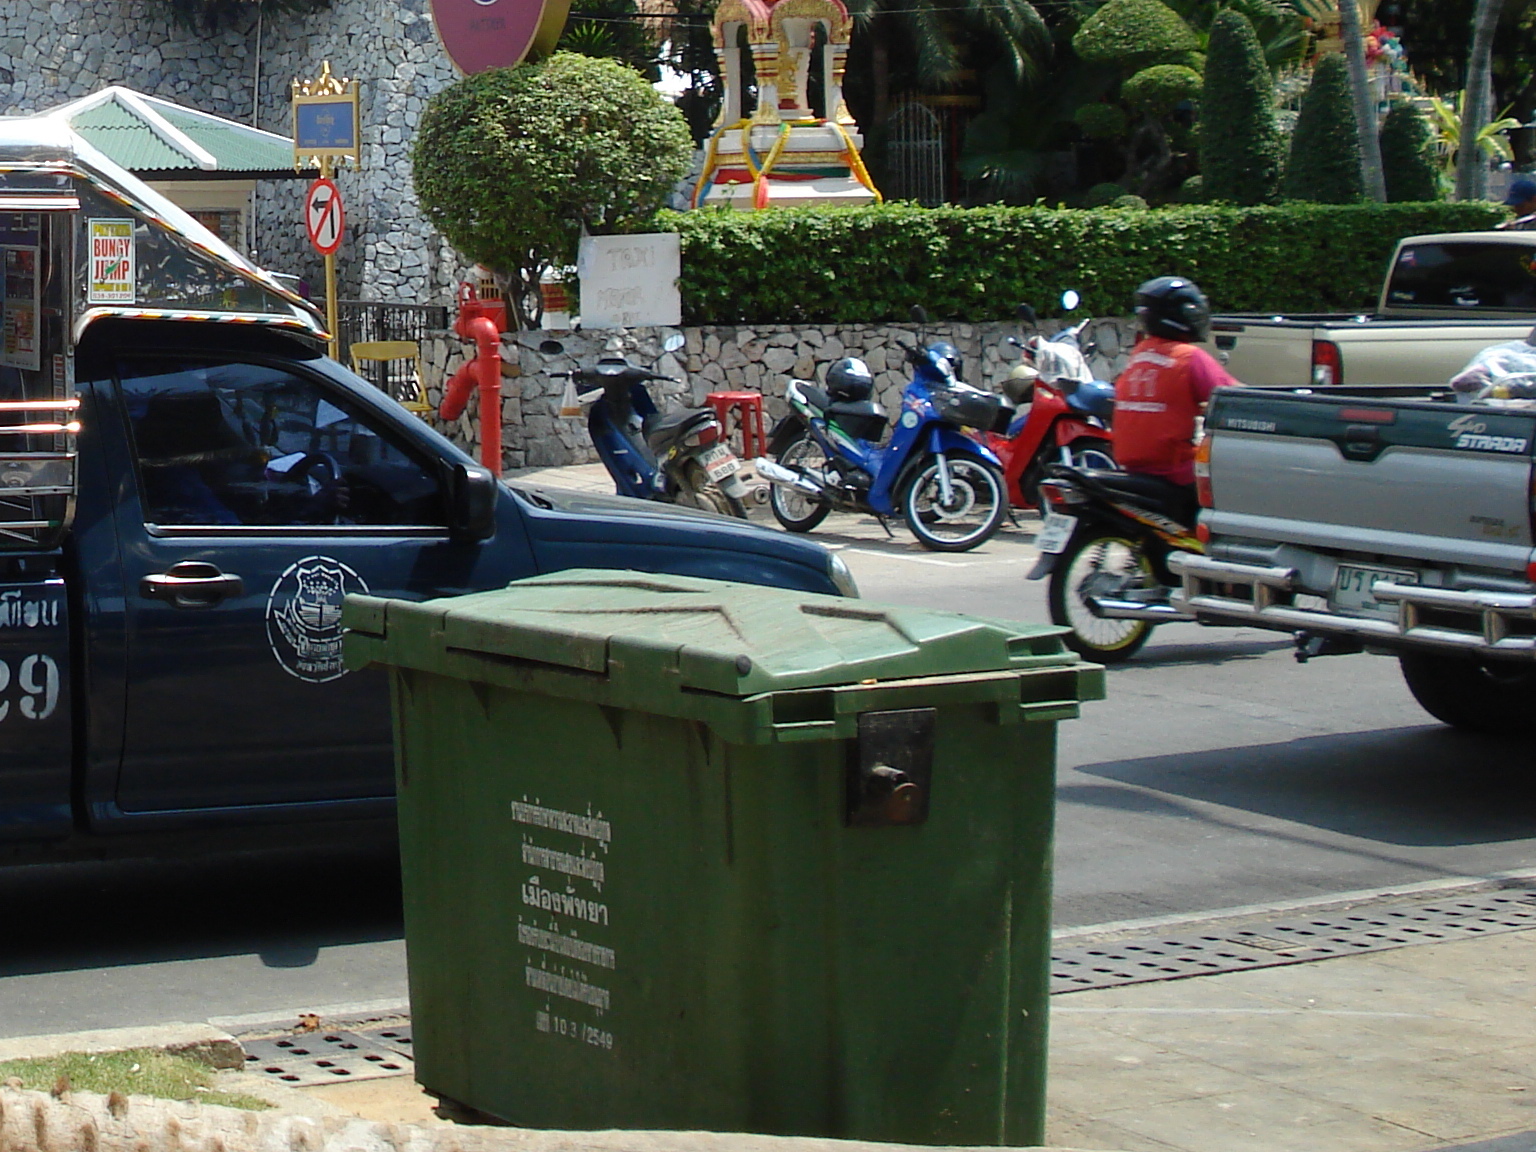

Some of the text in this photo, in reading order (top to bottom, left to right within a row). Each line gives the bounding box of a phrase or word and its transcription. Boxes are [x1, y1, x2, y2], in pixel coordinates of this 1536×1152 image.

[93, 239, 131, 257] BUNGY
[94, 260, 130, 280] JUMP
[1227, 418, 1276, 432] MITSUBISHI
[1455, 434, 1527, 453] STRADA
